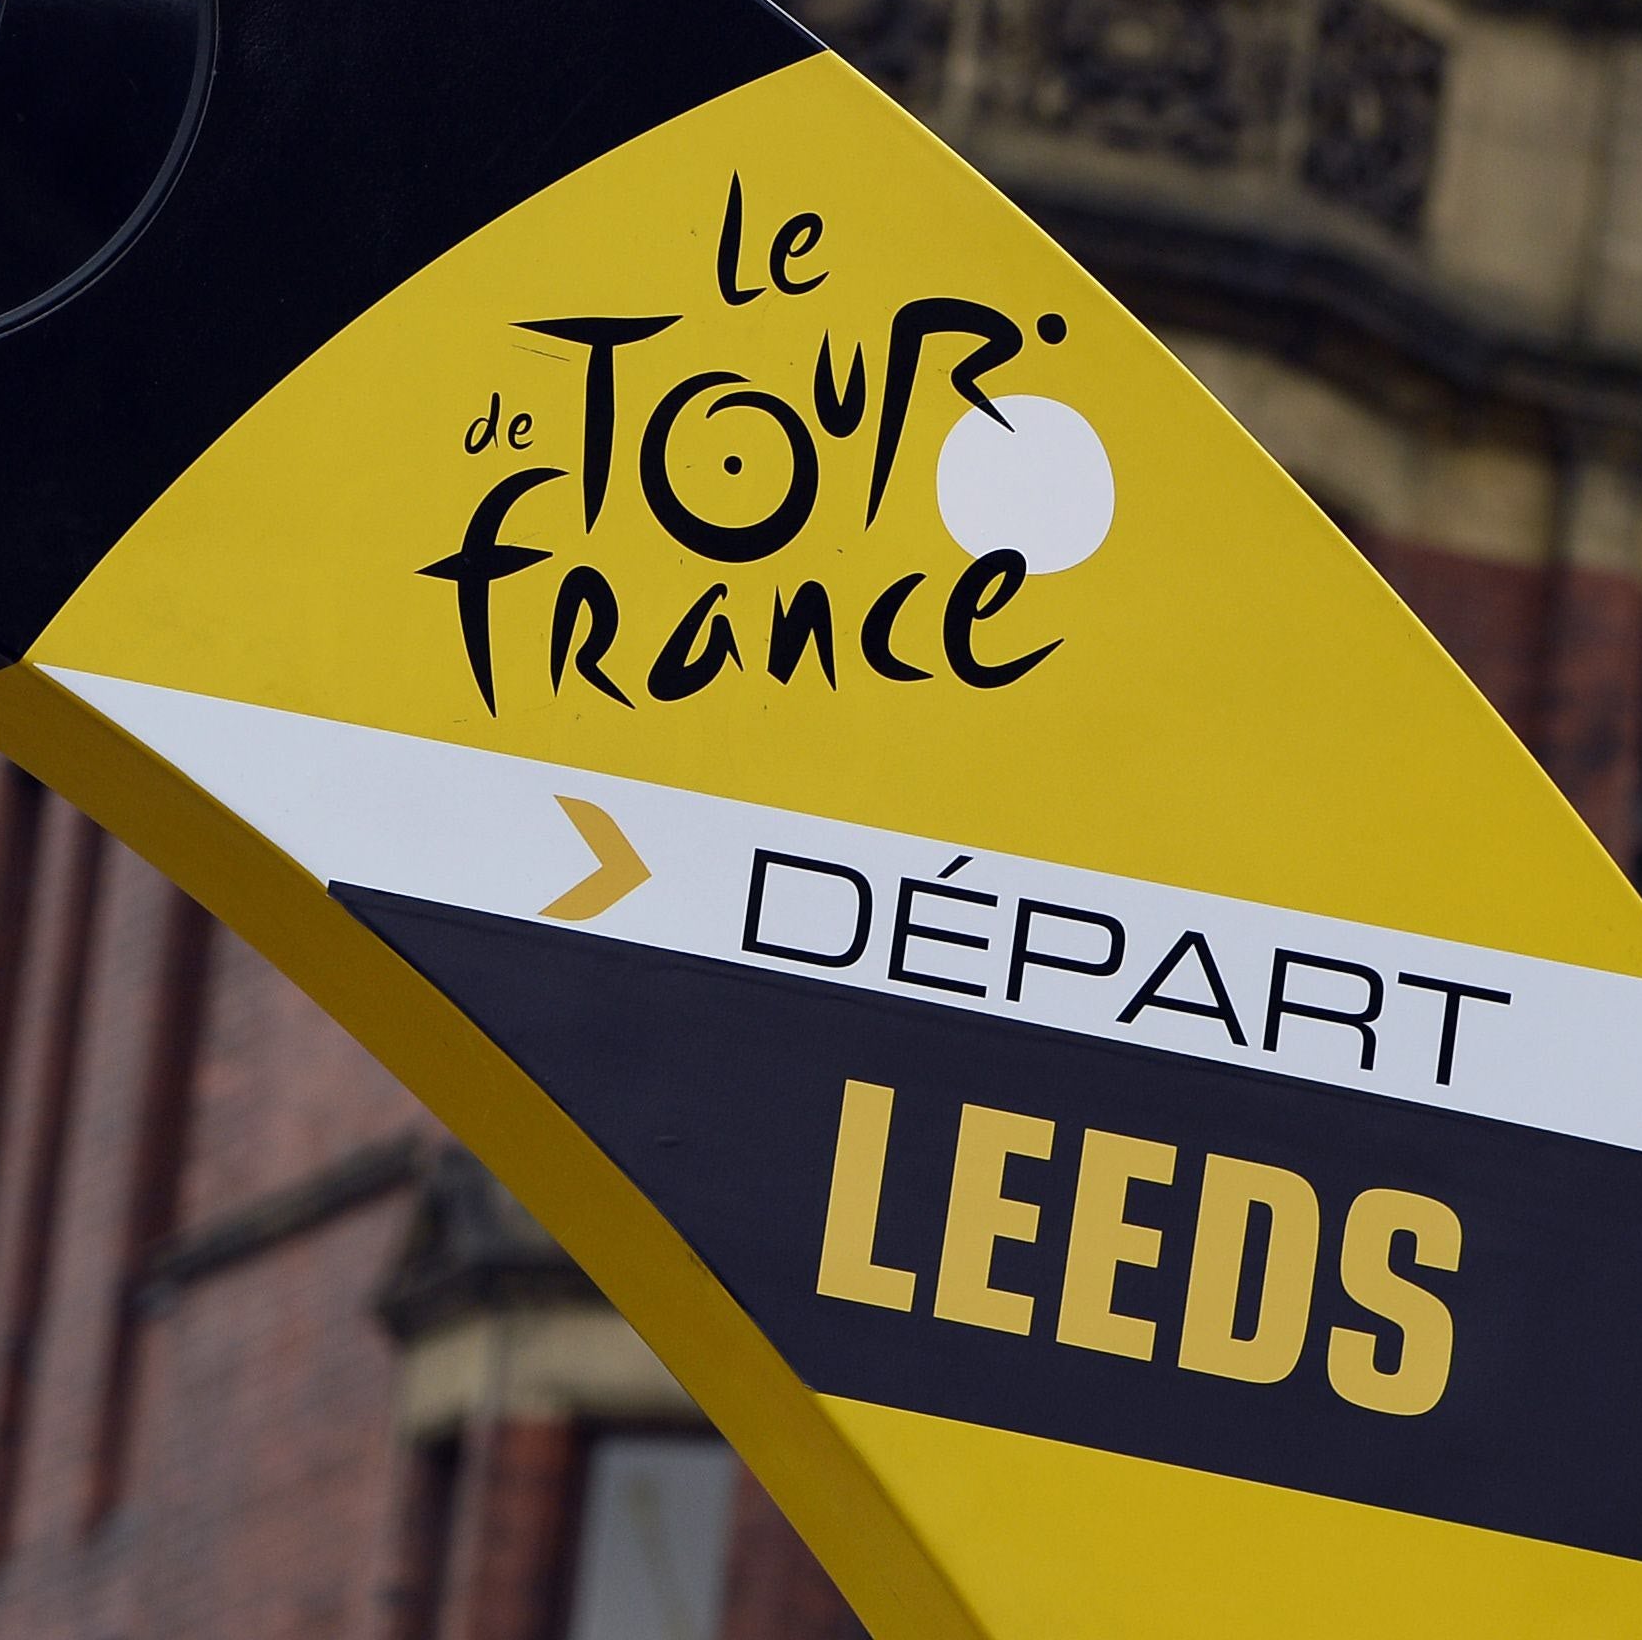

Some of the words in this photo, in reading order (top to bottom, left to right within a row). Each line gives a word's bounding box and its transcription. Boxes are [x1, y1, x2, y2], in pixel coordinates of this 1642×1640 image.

[717, 169, 831, 307] Le
[464, 392, 534, 456] de
[741, 847, 1512, 1087] DÉPART
[817, 1079, 1463, 1417] LEEDS
